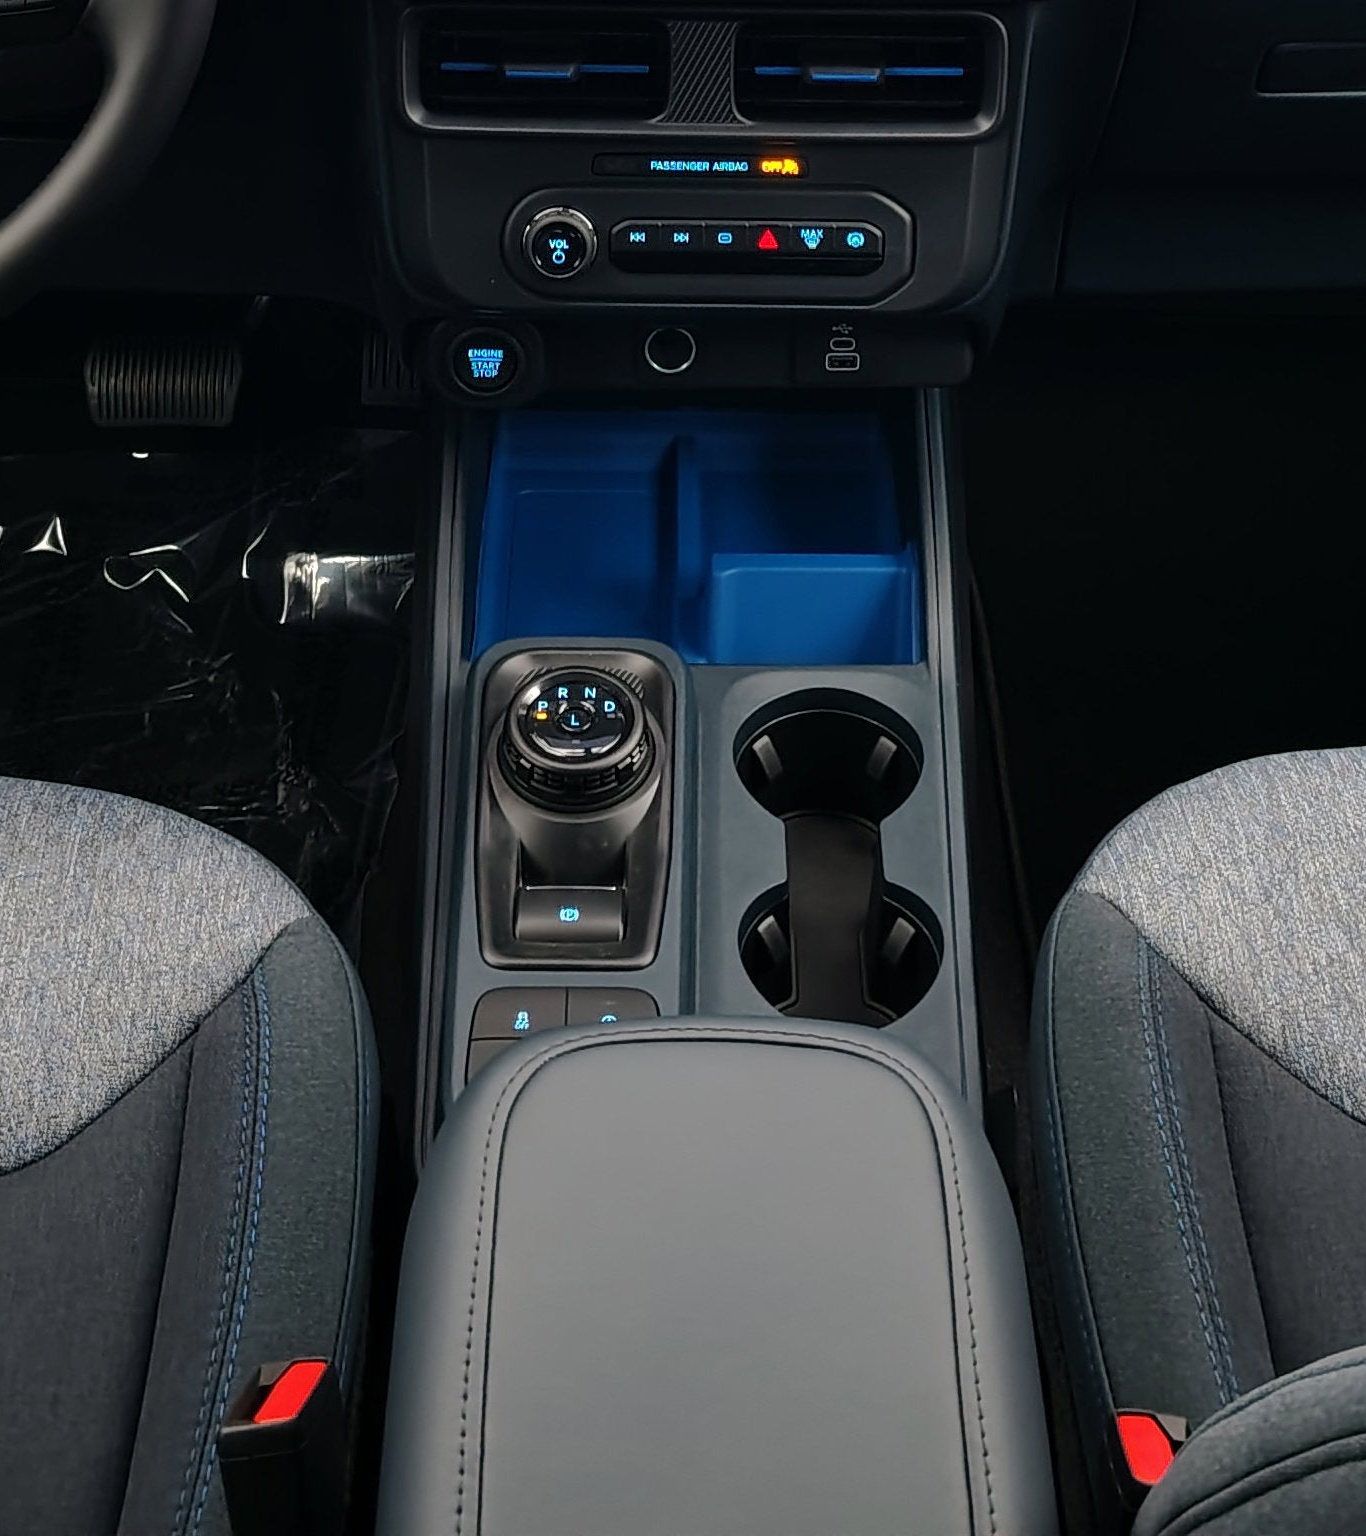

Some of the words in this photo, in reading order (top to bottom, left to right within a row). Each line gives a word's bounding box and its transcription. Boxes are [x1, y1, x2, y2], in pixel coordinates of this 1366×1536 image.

[650, 160, 709, 171] PASSENGER
[712, 161, 749, 172] AIRBAG
[761, 160, 782, 173] OFF
[801, 229, 824, 240] MAX
[549, 239, 569, 250] VOL
[468, 349, 503, 358] ENGINE
[471, 362, 501, 370] START
[473, 369, 498, 378] STOP
[558, 687, 569, 698] R
[584, 687, 596, 699] N
[538, 701, 549, 712] P
[604, 700, 615, 713] D
[571, 714, 579, 726] L
